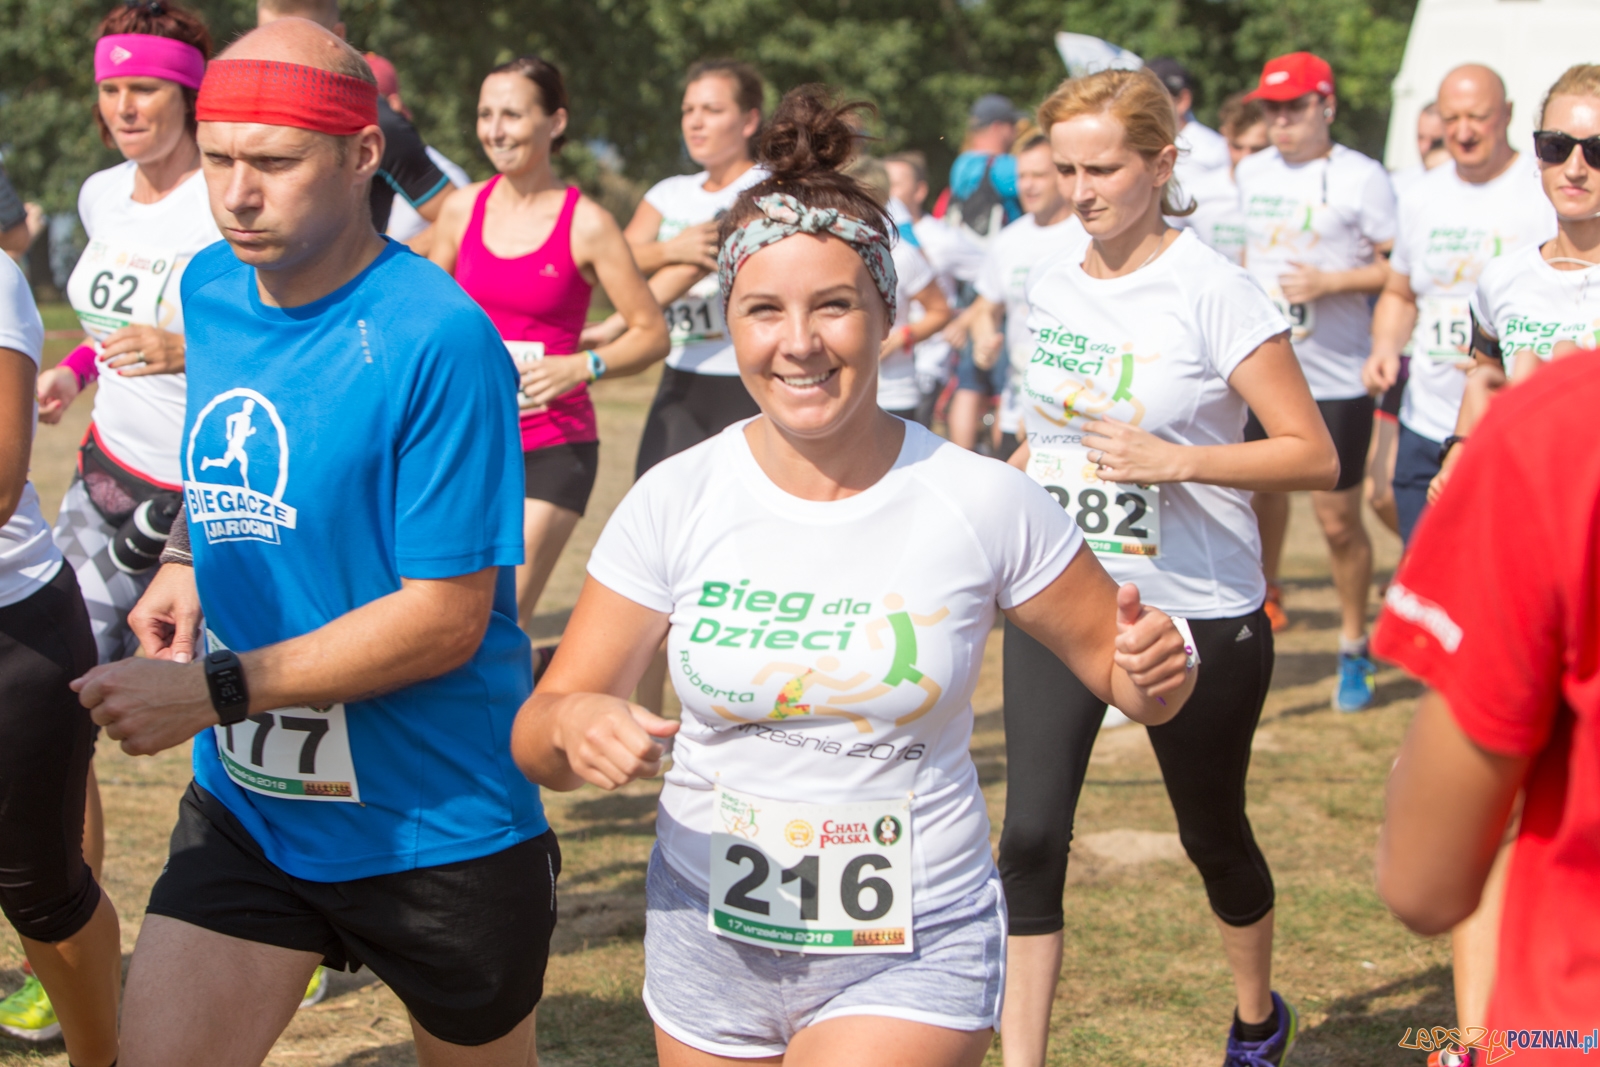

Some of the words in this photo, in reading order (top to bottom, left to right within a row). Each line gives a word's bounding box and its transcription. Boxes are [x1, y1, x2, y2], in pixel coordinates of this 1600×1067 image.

[90, 270, 138, 315] 62
[1039, 325, 1089, 355] Bieg
[1090, 343, 1116, 354] dla
[1506, 316, 1561, 337] Bieg
[1031, 346, 1104, 376] Dzieci
[188, 488, 288, 523] BIEGACZE
[209, 519, 275, 539] JAROCIN
[697, 579, 815, 622] Bieg
[822, 598, 872, 615] dla
[689, 617, 856, 651] Dzieci
[679, 649, 755, 704] Roberta
[846, 742, 926, 761] 2016
[256, 777, 288, 791] 2016
[724, 844, 894, 921] 216
[728, 918, 743, 930] 17
